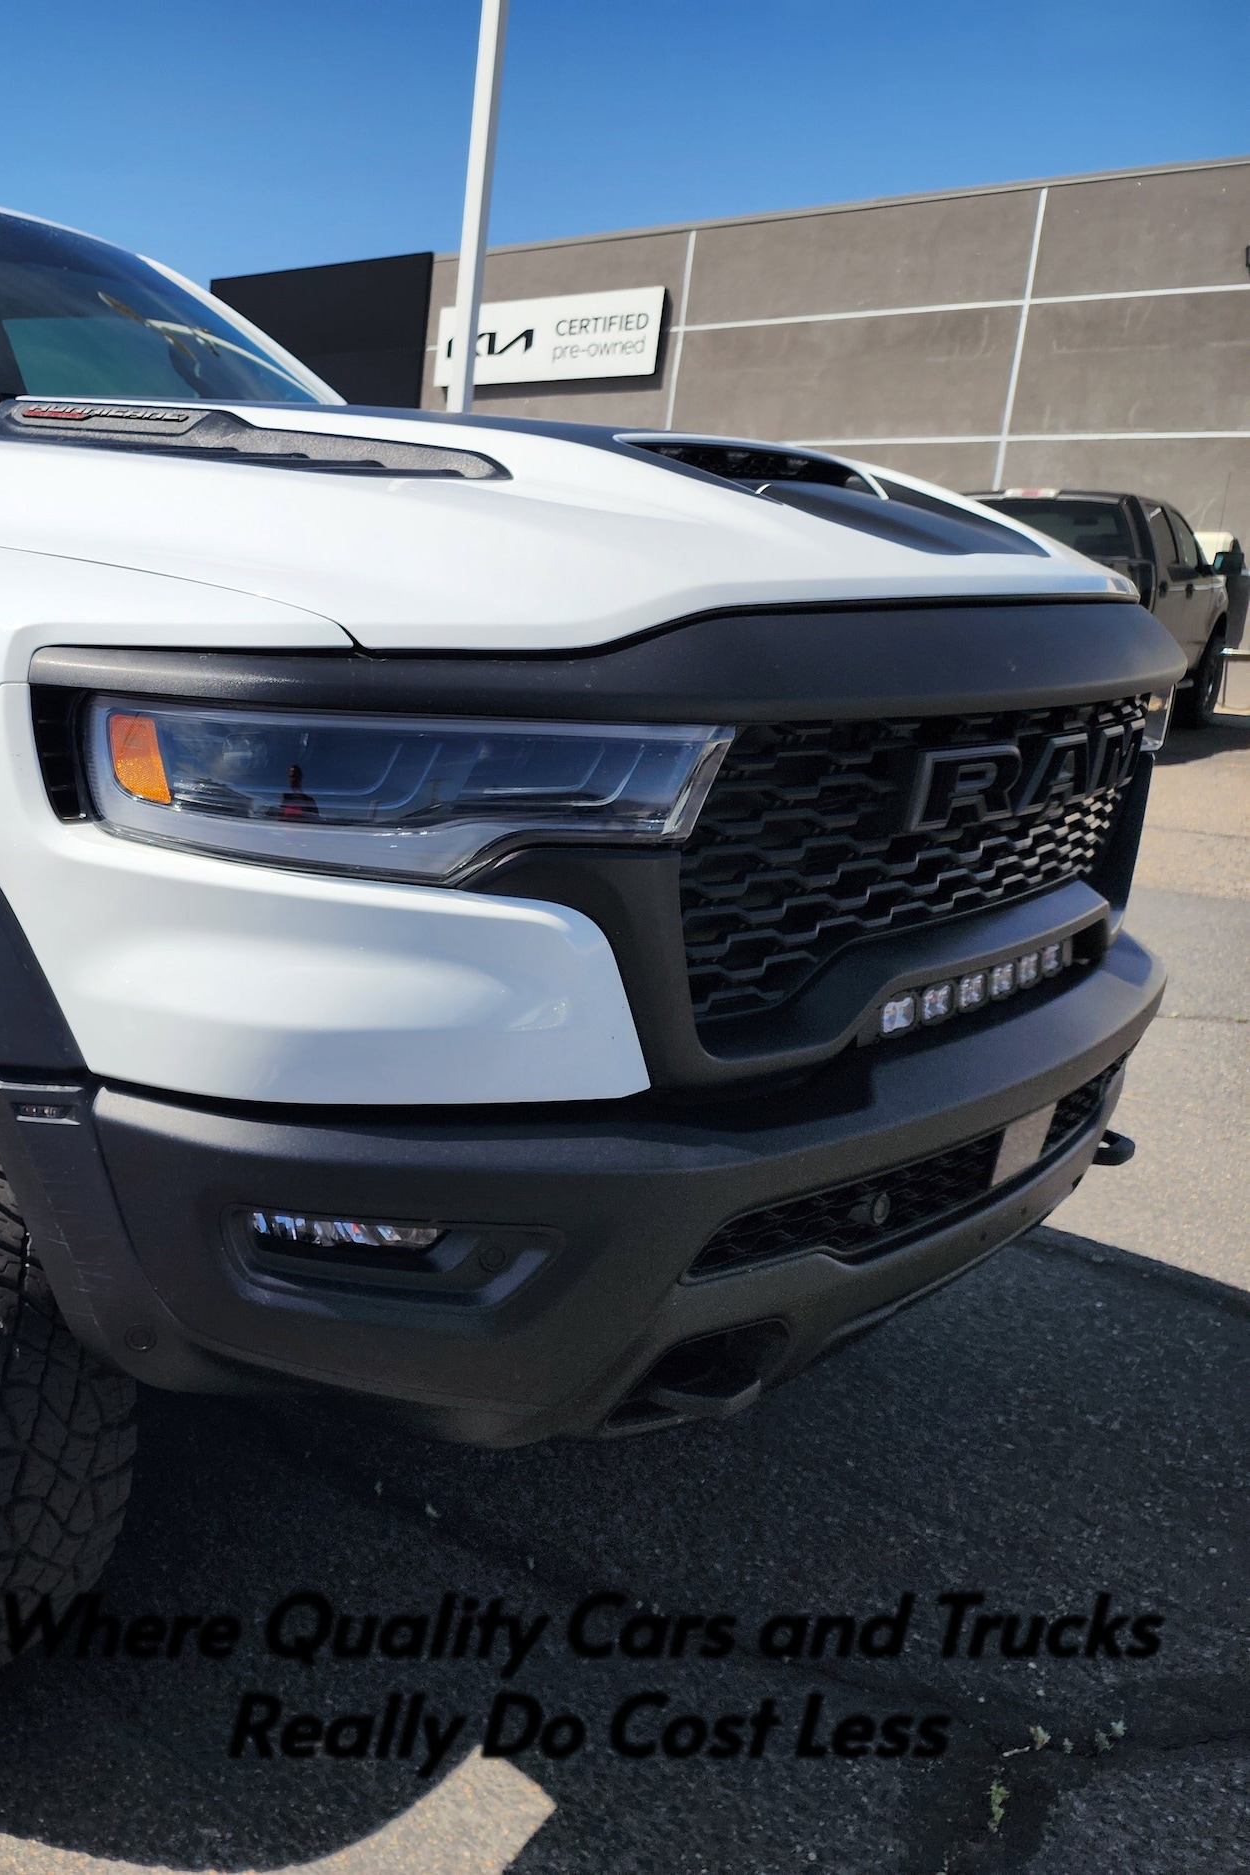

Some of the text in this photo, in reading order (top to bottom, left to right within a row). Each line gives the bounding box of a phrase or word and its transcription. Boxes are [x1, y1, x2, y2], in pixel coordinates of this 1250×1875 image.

[554, 312, 650, 338] CERTIFIED
[551, 336, 647, 363] pre-owned
[903, 716, 1147, 833] RAM
